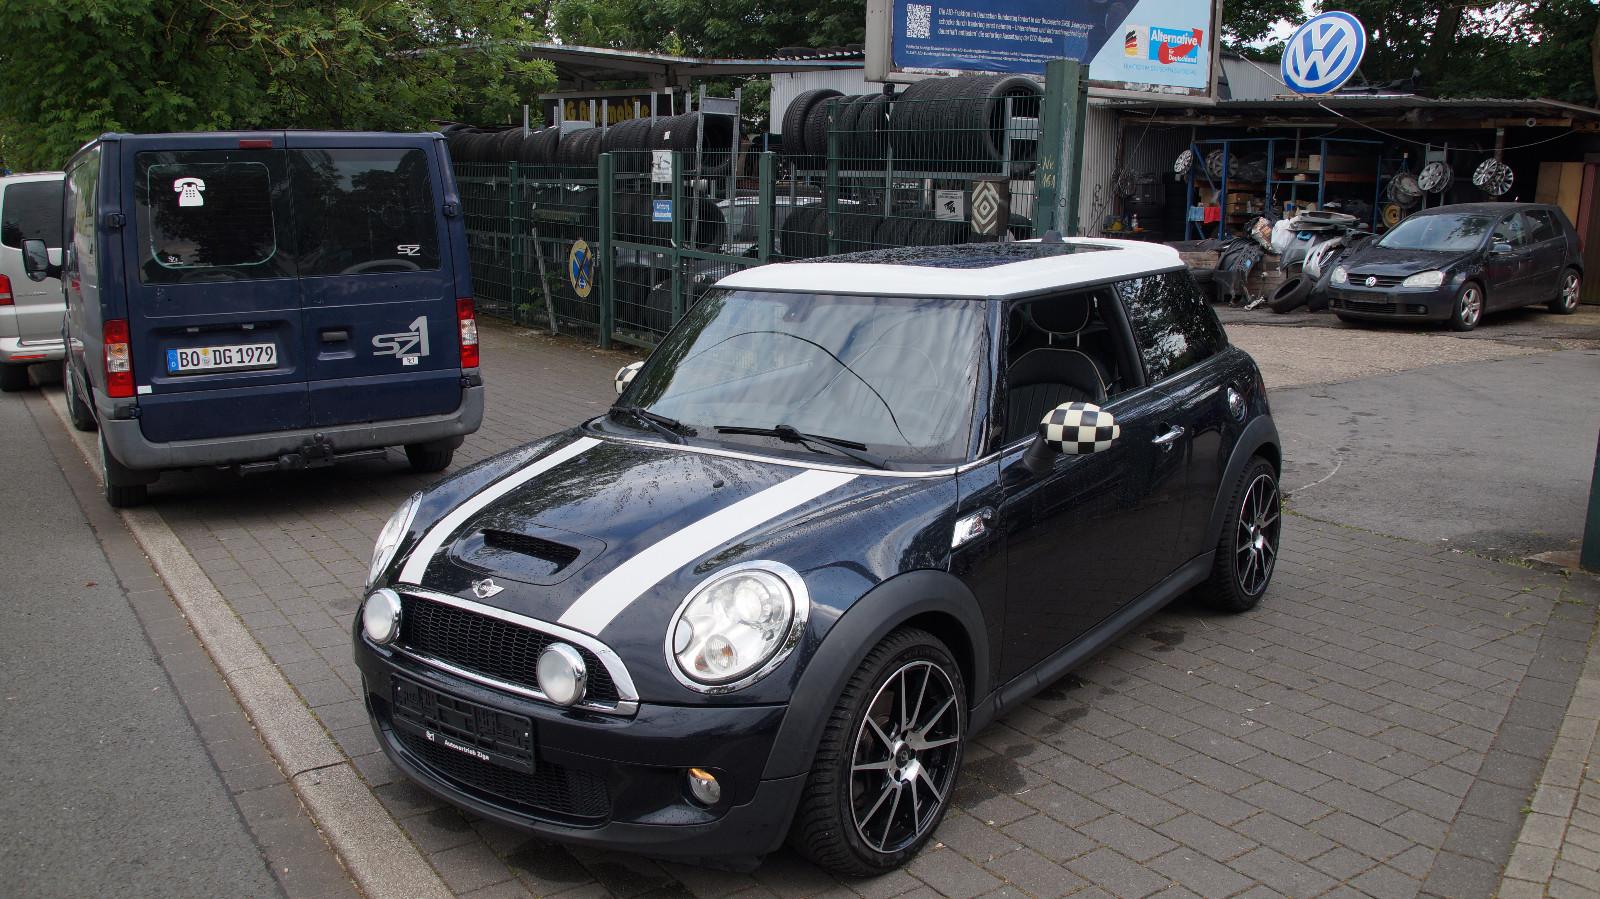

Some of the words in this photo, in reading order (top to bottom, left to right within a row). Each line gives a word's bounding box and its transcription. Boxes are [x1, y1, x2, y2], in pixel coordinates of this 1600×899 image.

[1151, 29, 1198, 46] Alternative
[1168, 54, 1197, 63] Deutschland
[1286, 17, 1357, 88] VW
[179, 350, 201, 367] BO
[212, 349, 232, 365] DG
[236, 346, 274, 364] 1979
